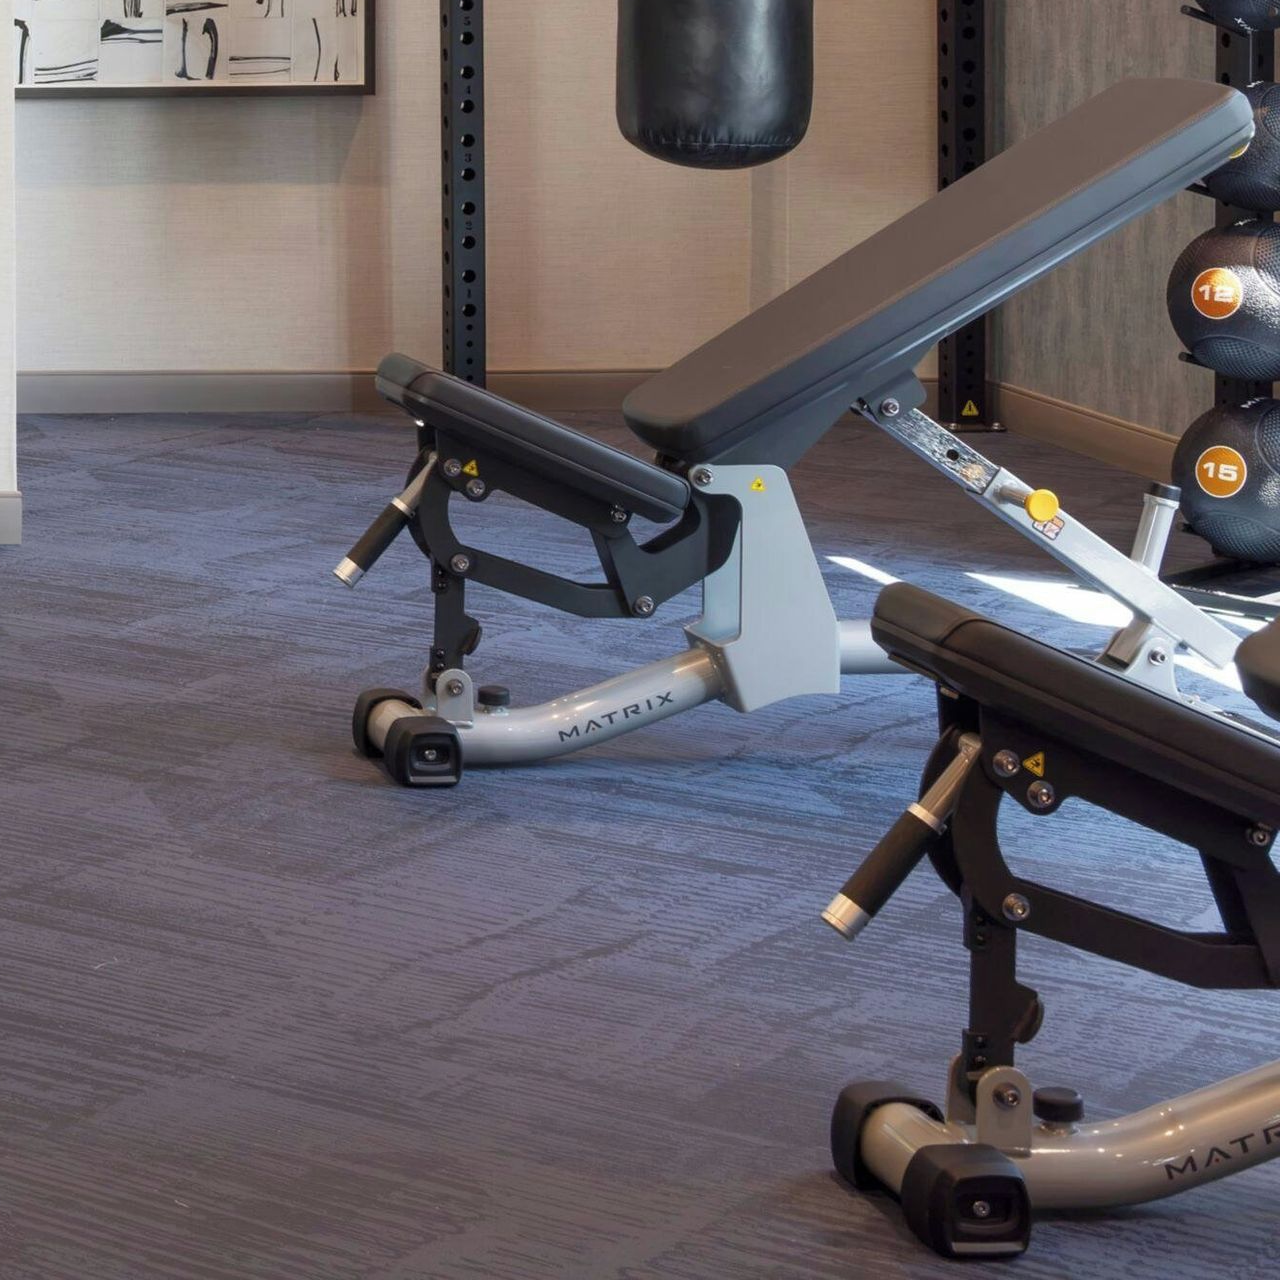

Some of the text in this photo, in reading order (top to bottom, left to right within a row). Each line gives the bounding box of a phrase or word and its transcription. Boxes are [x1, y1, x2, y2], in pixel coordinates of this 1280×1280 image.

[1198, 284, 1235, 303] 12
[1202, 462, 1238, 482] 15
[558, 691, 674, 742] MATRIX
